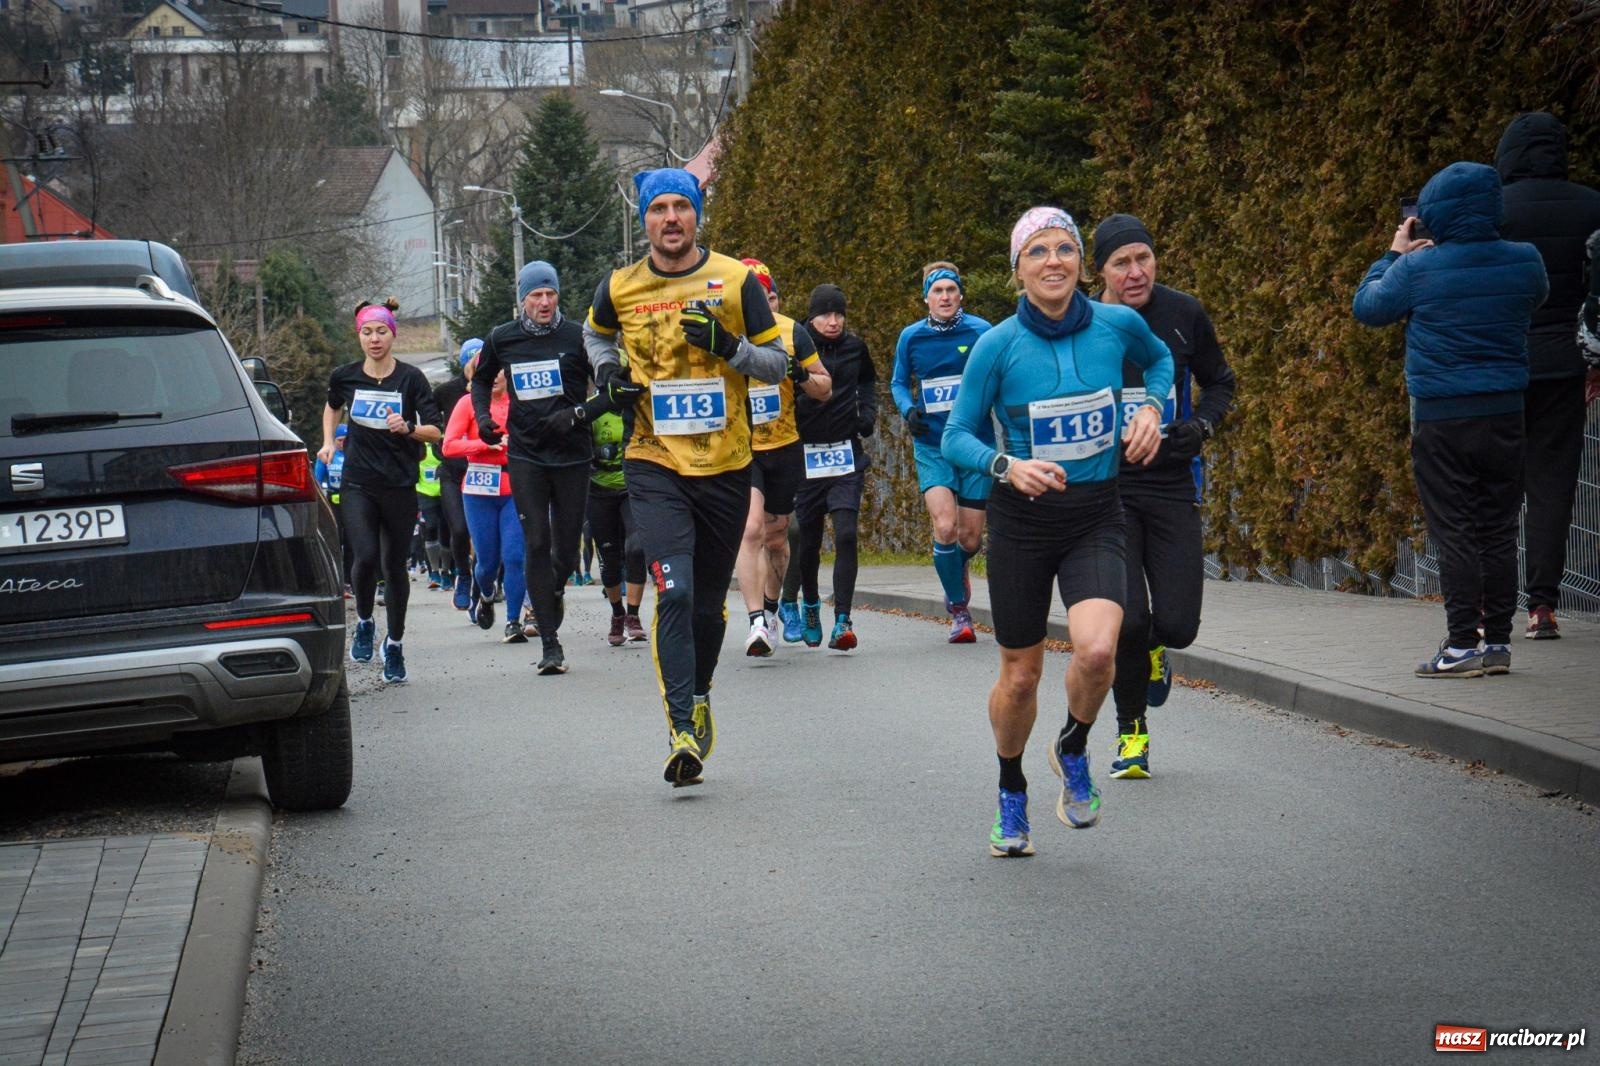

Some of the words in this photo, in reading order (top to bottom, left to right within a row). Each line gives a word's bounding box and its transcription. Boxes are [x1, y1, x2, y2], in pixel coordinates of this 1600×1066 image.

[635, 300, 685, 314] ENERGY
[520, 371, 553, 389] 188
[934, 386, 953, 402] 97
[365, 401, 387, 418] 76
[666, 394, 713, 419] 113
[1048, 410, 1104, 443] 118
[814, 450, 846, 468] 133
[469, 472, 493, 486] 138
[15, 508, 115, 544] 1239P
[0, 577, 84, 594] Ateca
